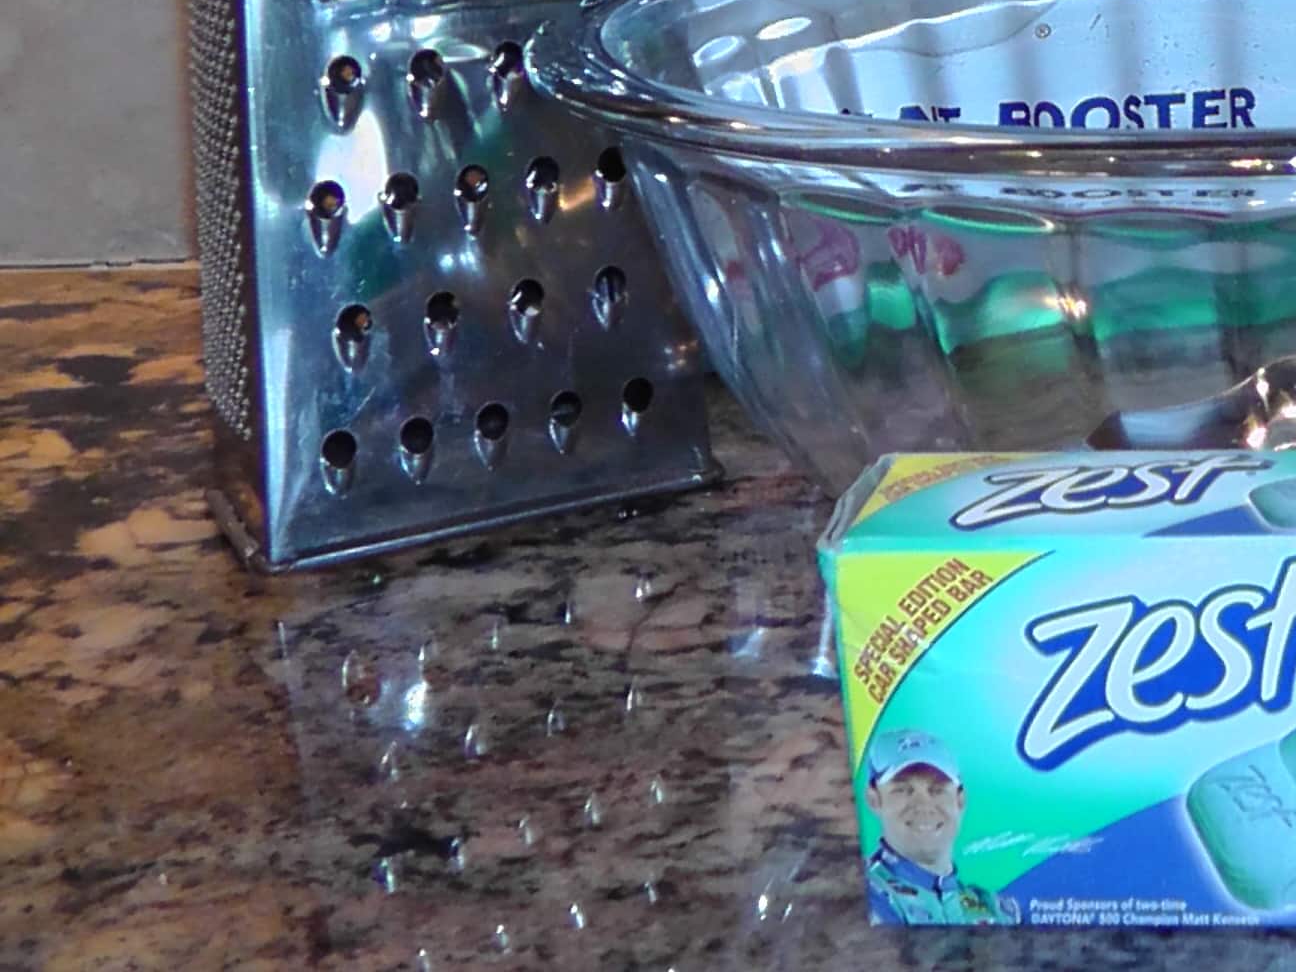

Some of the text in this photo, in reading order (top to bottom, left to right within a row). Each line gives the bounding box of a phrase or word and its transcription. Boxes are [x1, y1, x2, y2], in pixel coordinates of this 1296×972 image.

[853, 615, 907, 686] SPECIAL
[898, 557, 971, 618] EDITION
[868, 569, 994, 705] CAR SHAPED BAR
[1029, 898, 1064, 912] Proud
[1066, 898, 1119, 913] Sponsors
[1120, 897, 1135, 912] of
[1122, 912, 1180, 927] Champion
[1181, 912, 1211, 926] Matt
